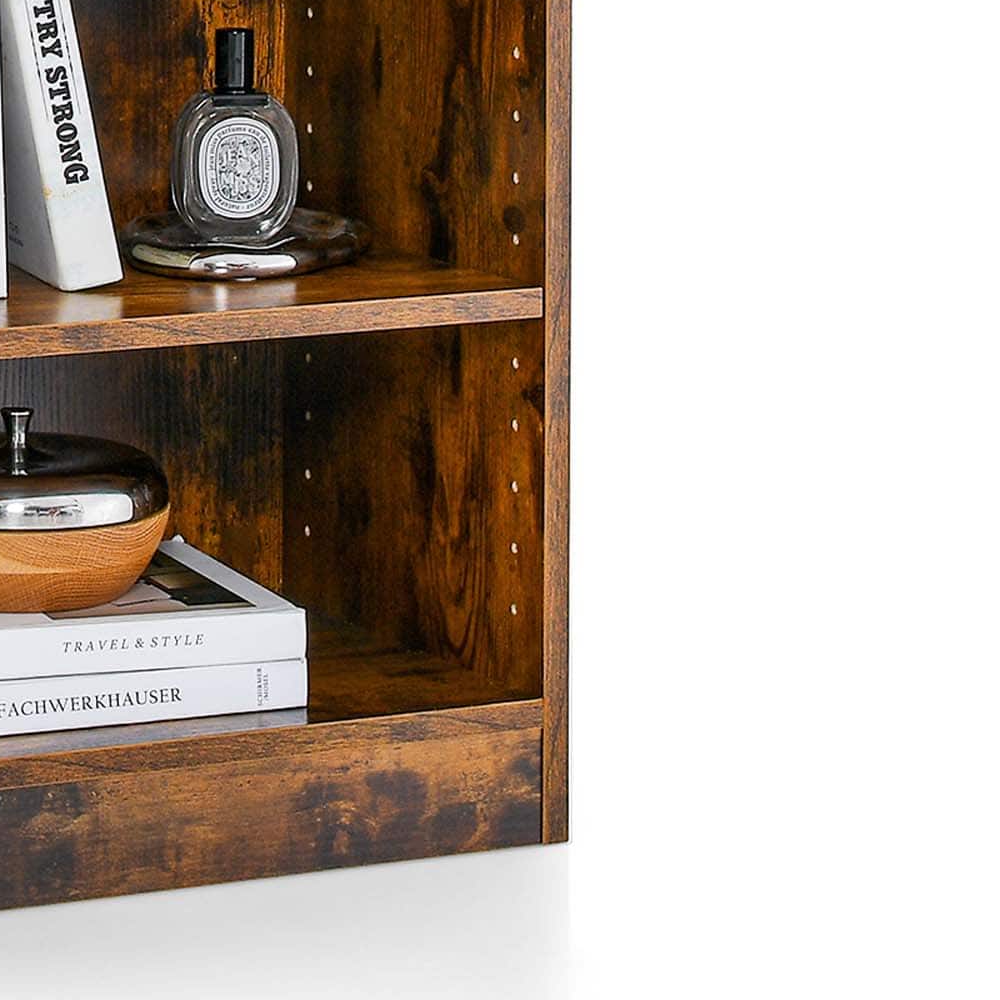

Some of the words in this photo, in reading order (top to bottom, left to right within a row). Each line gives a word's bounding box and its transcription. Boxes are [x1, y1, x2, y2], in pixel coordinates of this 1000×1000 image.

[45, 65, 90, 185] STRONG
[63, 637, 130, 653] TRAVEL
[134, 636, 145, 649] &
[149, 633, 205, 649] STYLE
